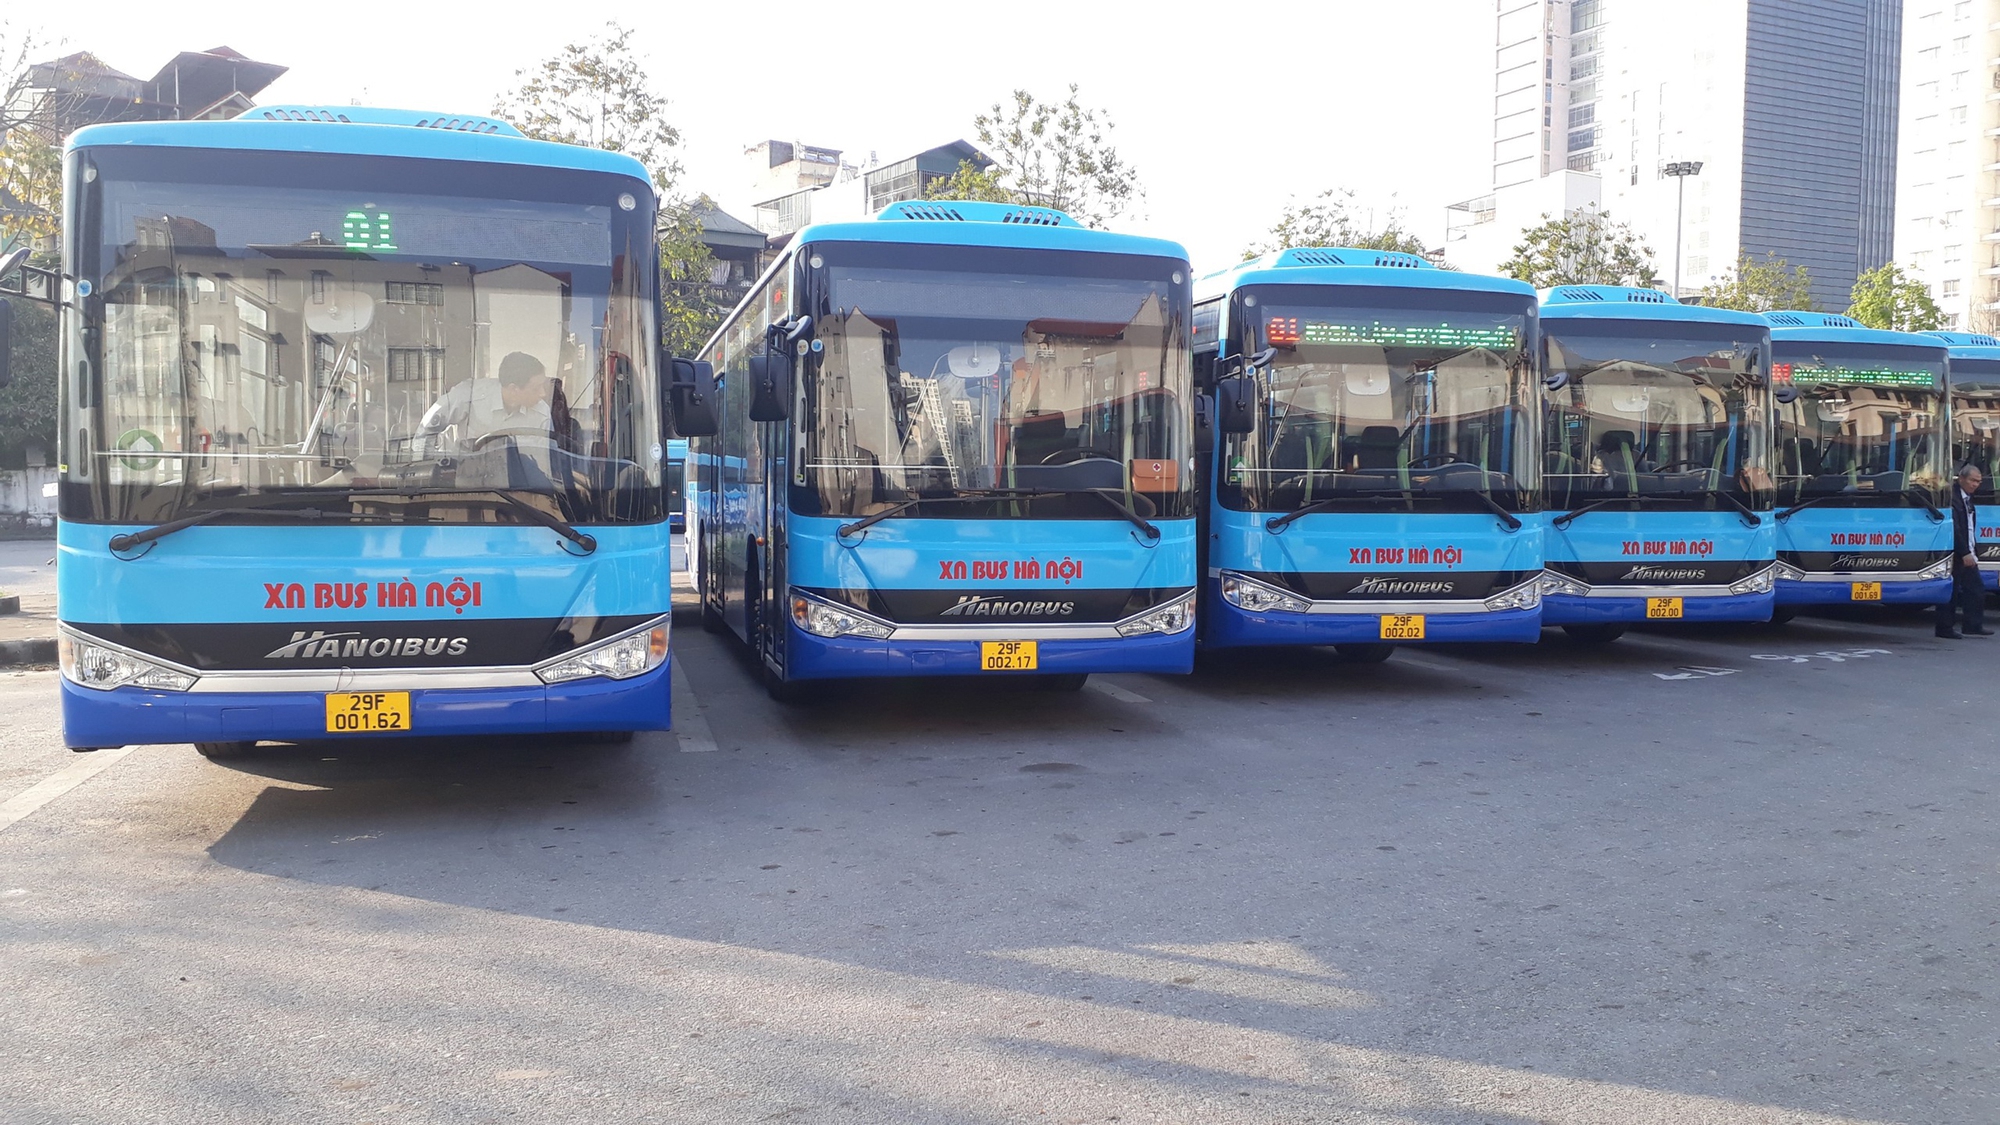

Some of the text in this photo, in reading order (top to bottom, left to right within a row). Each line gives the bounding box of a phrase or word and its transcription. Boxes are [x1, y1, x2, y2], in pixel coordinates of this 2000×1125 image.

[1848, 533, 1867, 545] BUS
[1869, 531, 1883, 545] HÀ
[1643, 541, 1667, 555] BUS
[1669, 538, 1686, 555] HÀ
[1348, 545, 1462, 569] XN BUS HÀ NỘI
[938, 556, 1083, 585] XN BUS HÀ NỘI
[1620, 565, 1706, 580] HANOIBUS
[1347, 576, 1454, 594] HANOIBUS
[1860, 583, 1873, 591] 29F
[263, 576, 482, 615] XN BUS HÀ NỘI
[1657, 598, 1673, 608] 29F
[939, 595, 1075, 616] HANOIBUS
[1650, 608, 1679, 617] 002.00
[1393, 616, 1412, 626] 29F
[1385, 627, 1420, 638] 002.02
[264, 630, 469, 659] HANOIBUS
[997, 643, 1021, 655] 29F
[987, 656, 1031, 668] 002.17
[349, 694, 386, 711] 29F
[335, 712, 402, 730] 001.62
